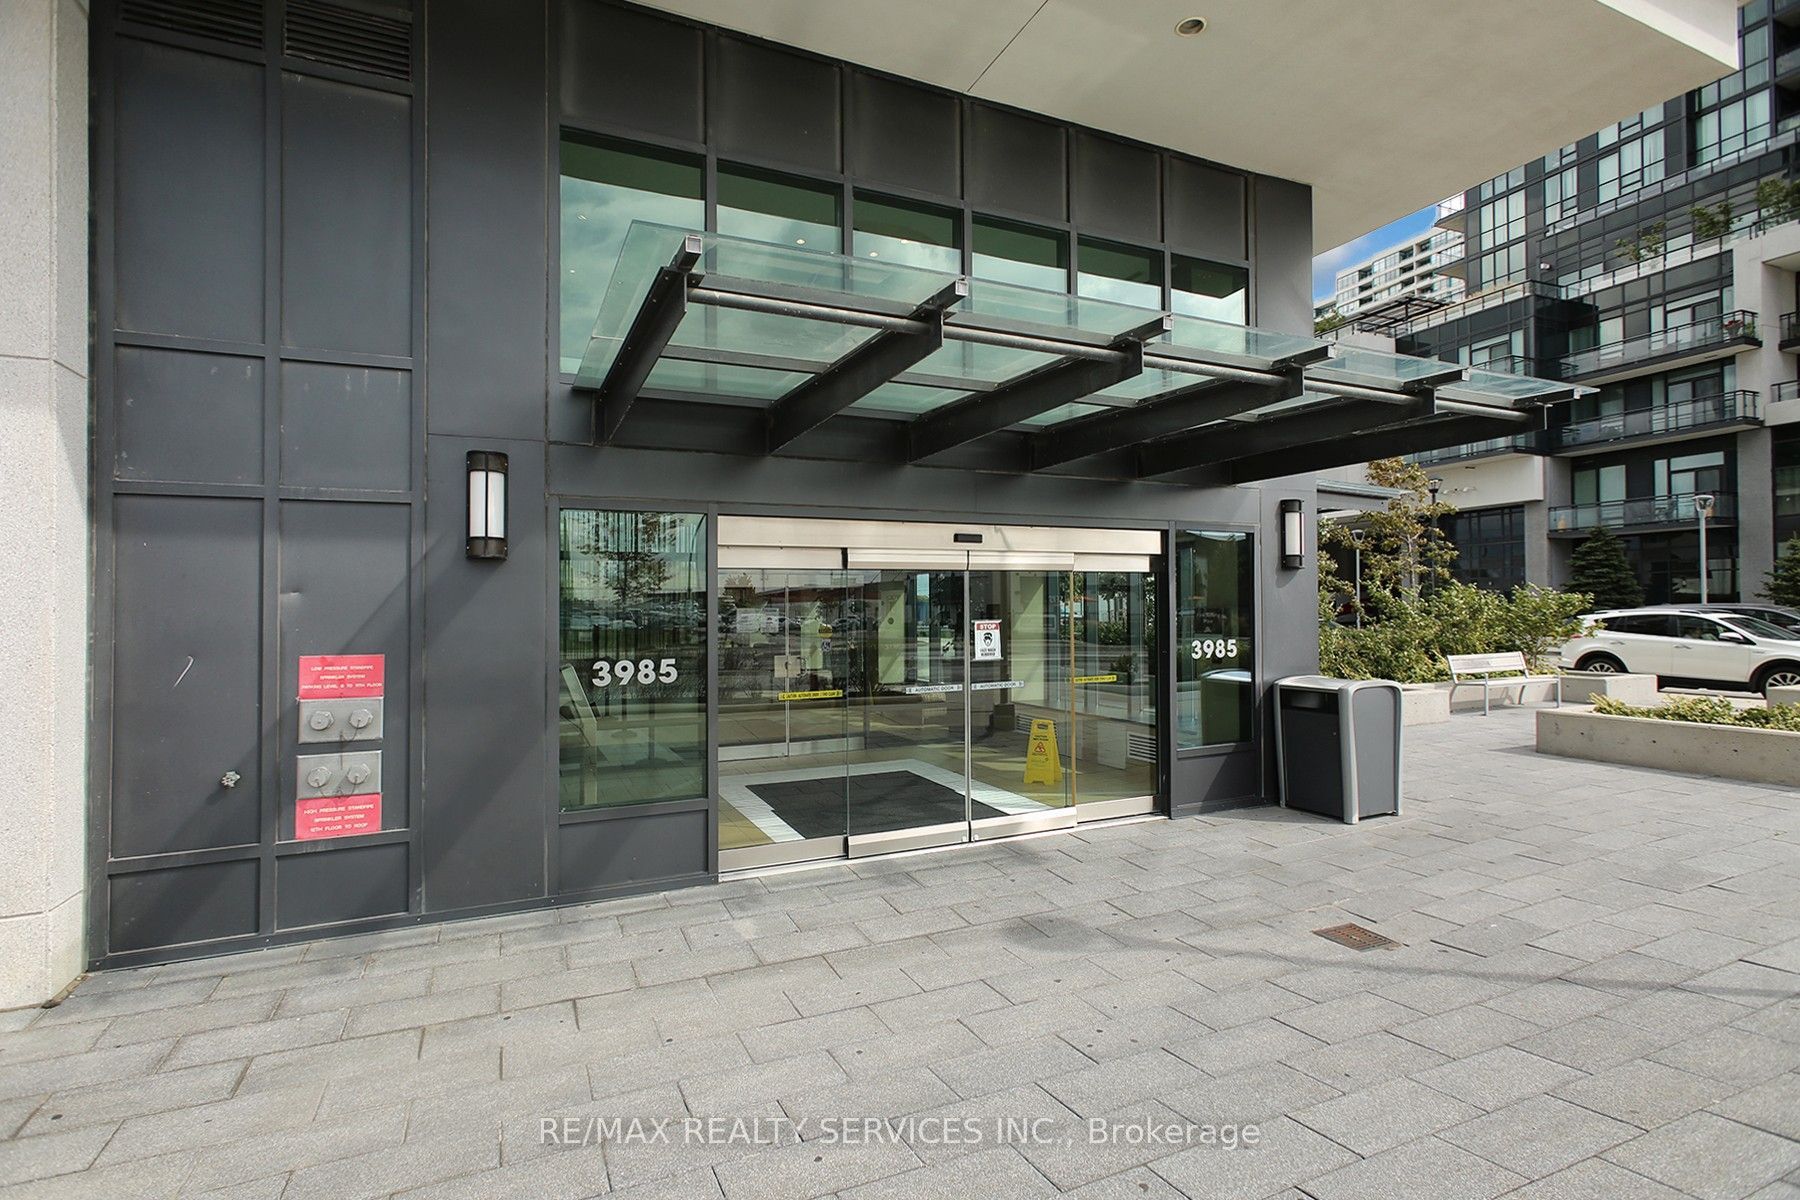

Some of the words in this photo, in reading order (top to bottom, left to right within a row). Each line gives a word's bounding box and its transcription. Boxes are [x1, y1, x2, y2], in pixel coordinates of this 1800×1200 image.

[1191, 639, 1238, 660] 3985
[592, 658, 678, 687] 3985
[313, 815, 342, 823] SPRINKLER
